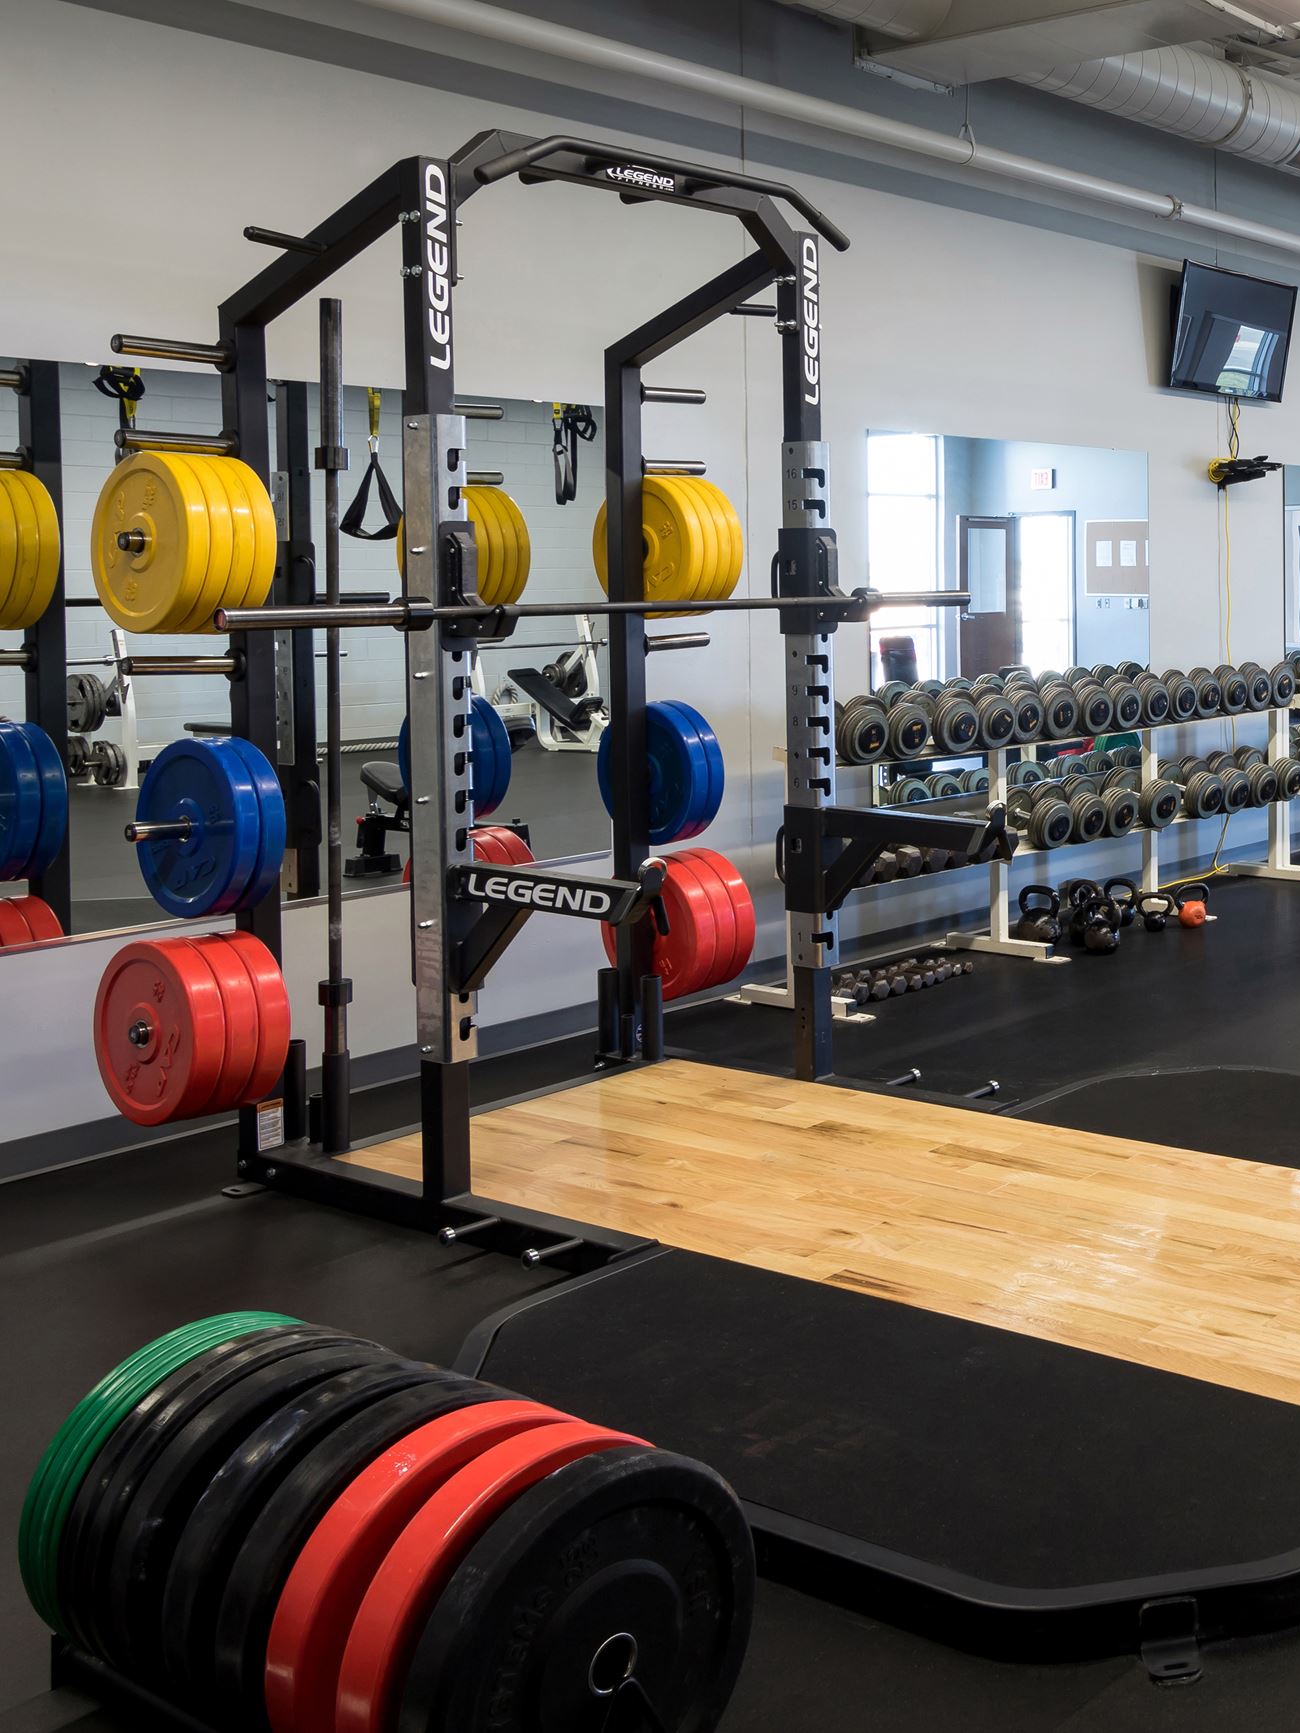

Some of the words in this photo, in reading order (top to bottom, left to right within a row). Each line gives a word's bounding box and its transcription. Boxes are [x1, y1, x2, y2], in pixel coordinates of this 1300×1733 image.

[617, 167, 674, 186] LEGEND
[425, 164, 451, 370] LEGEND
[803, 238, 819, 406] LEGEND
[786, 468, 797, 479] 16
[787, 500, 798, 511] 15
[468, 873, 610, 914] LEGEND
